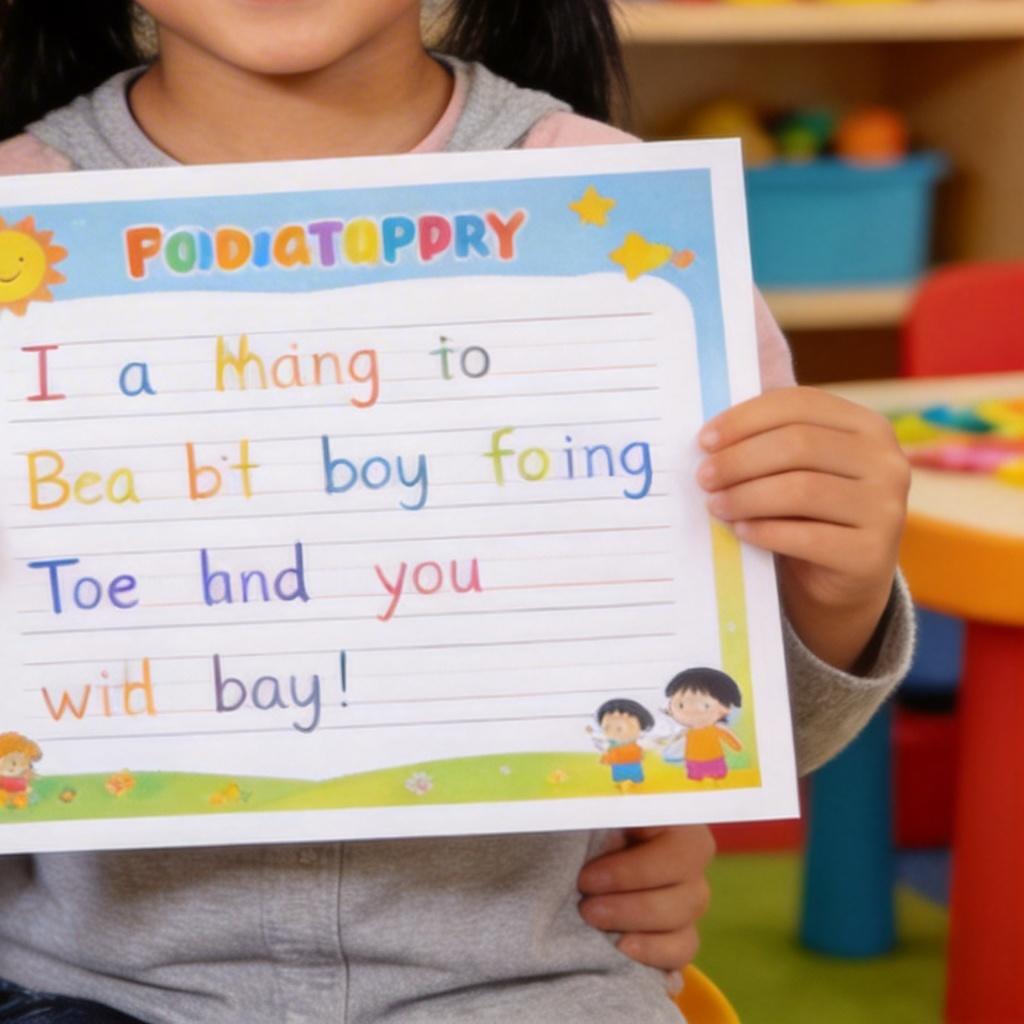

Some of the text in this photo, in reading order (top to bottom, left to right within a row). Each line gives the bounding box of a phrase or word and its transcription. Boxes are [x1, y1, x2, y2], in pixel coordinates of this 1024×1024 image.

[21, 344, 66, 401] I
[119, 361, 156, 396] a
[26, 449, 141, 511] Bea
[321, 435, 428, 511] boy
[483, 427, 654, 499] foing
[27, 558, 140, 614] Toe
[374, 558, 483, 622] you
[213, 649, 349, 734] bay!
